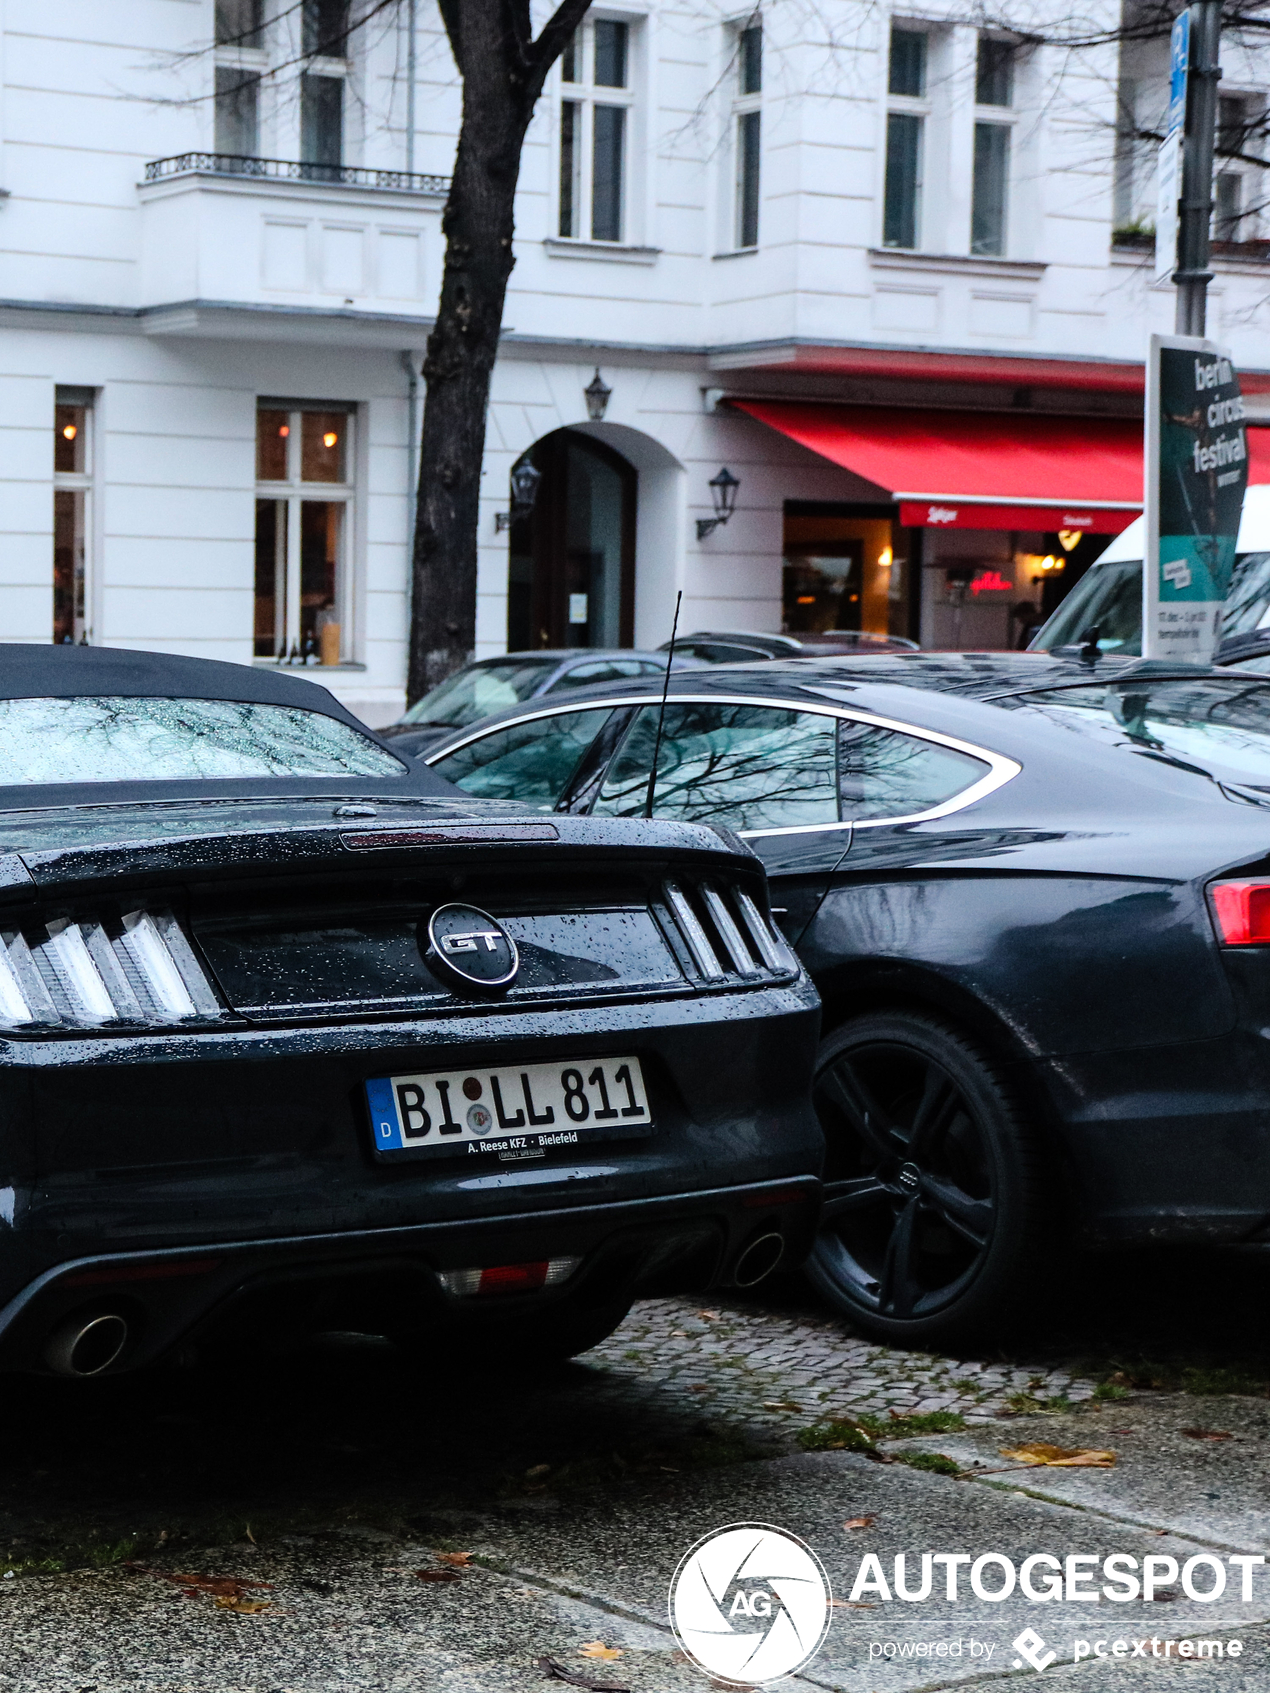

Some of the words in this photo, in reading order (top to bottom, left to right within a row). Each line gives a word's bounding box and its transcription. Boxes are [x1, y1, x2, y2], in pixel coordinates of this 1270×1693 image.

[1194, 357, 1232, 391] berlin
[1207, 393, 1243, 428] circus
[1193, 427, 1246, 473] festival
[441, 932, 502, 954] GT
[380, 1122, 391, 1138] D
[561, 1065, 645, 1122] 811
[468, 1143, 478, 1153] A.
[480, 1141, 508, 1152] Reese
[510, 1138, 527, 1149] KFZ
[538, 1132, 578, 1146] Bielefeld
